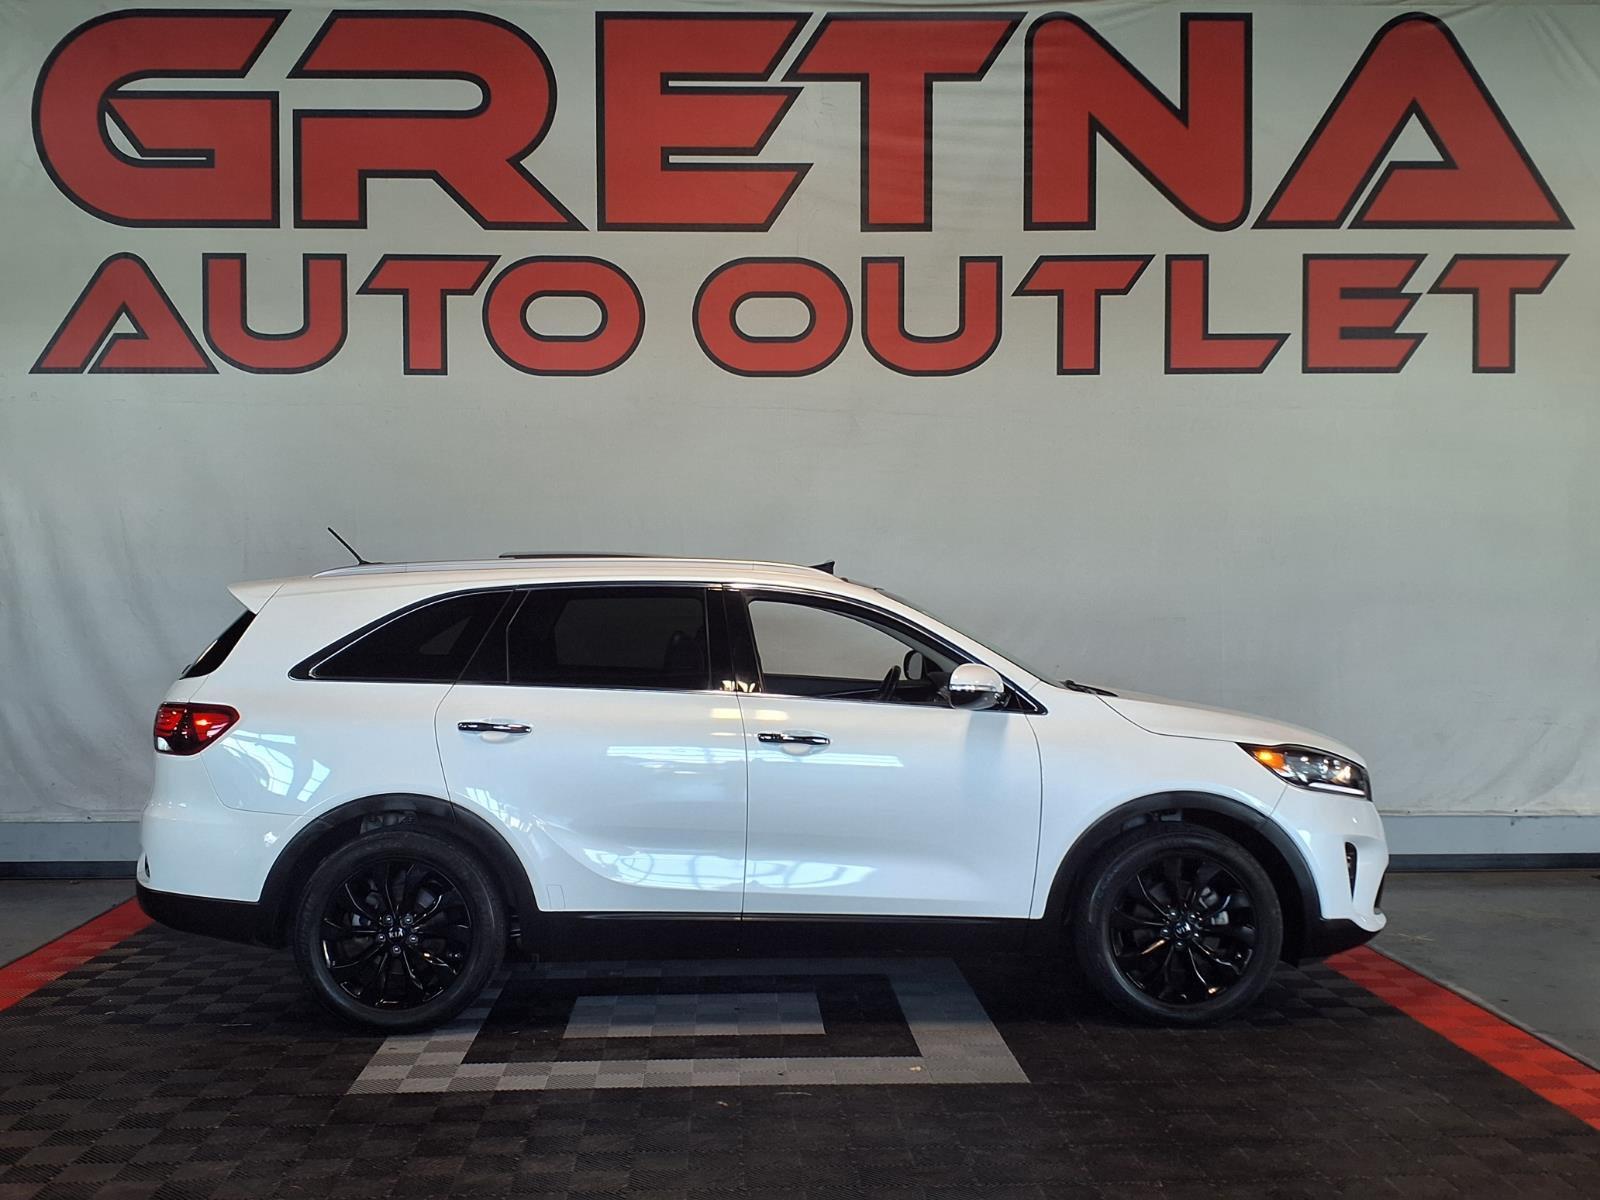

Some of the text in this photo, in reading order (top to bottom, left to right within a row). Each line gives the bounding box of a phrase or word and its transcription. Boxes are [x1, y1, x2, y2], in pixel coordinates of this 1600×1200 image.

[31, 8, 1574, 232] GRETNA
[29, 252, 1569, 377] AUTO OUTLET
